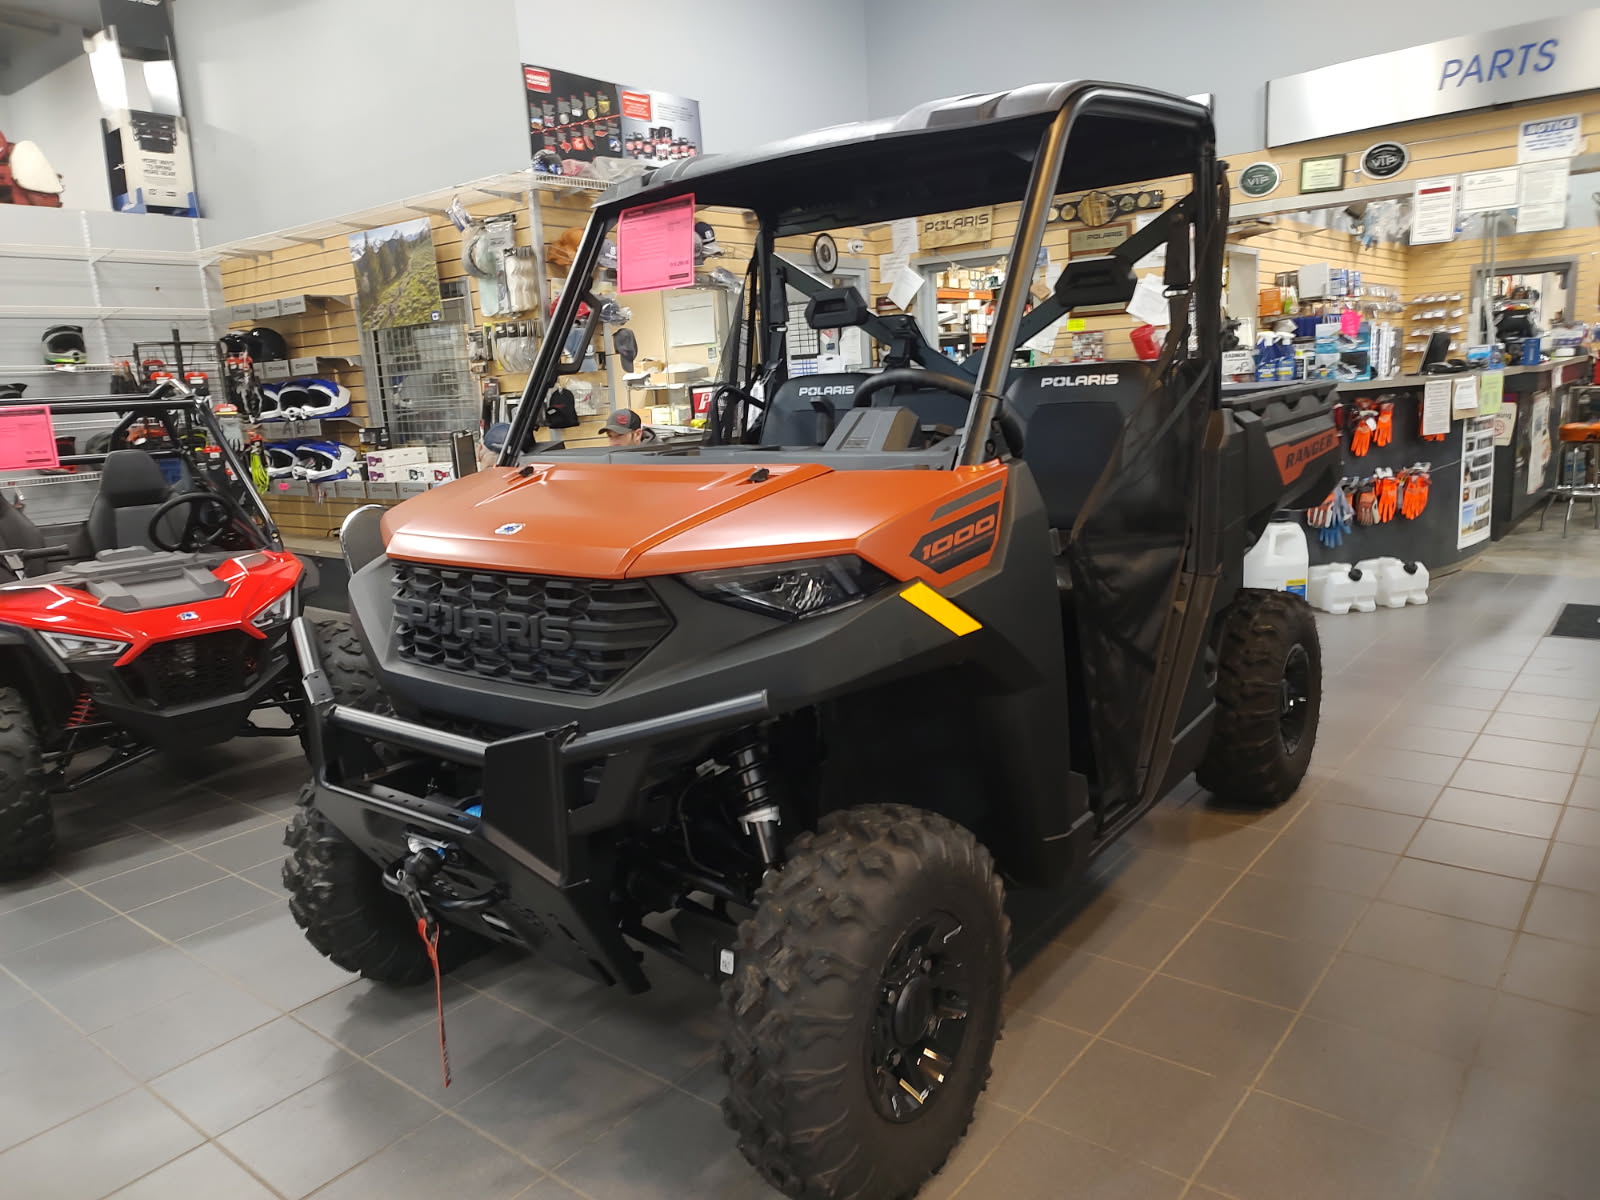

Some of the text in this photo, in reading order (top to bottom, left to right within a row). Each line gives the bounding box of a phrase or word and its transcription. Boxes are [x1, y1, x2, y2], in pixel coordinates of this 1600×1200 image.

[1438, 39, 1559, 91] PARTS
[1527, 117, 1575, 135] NOTICE
[1371, 154, 1398, 167] VIP
[1247, 174, 1270, 186] VIP
[925, 213, 989, 233] POLARIS
[1087, 231, 1124, 240] POLARIS
[1040, 374, 1119, 388] POLARIS
[799, 385, 855, 397] POLARIS
[1285, 433, 1334, 469] RANGER
[922, 514, 996, 561] 1000
[407, 598, 573, 651] POLARIS
